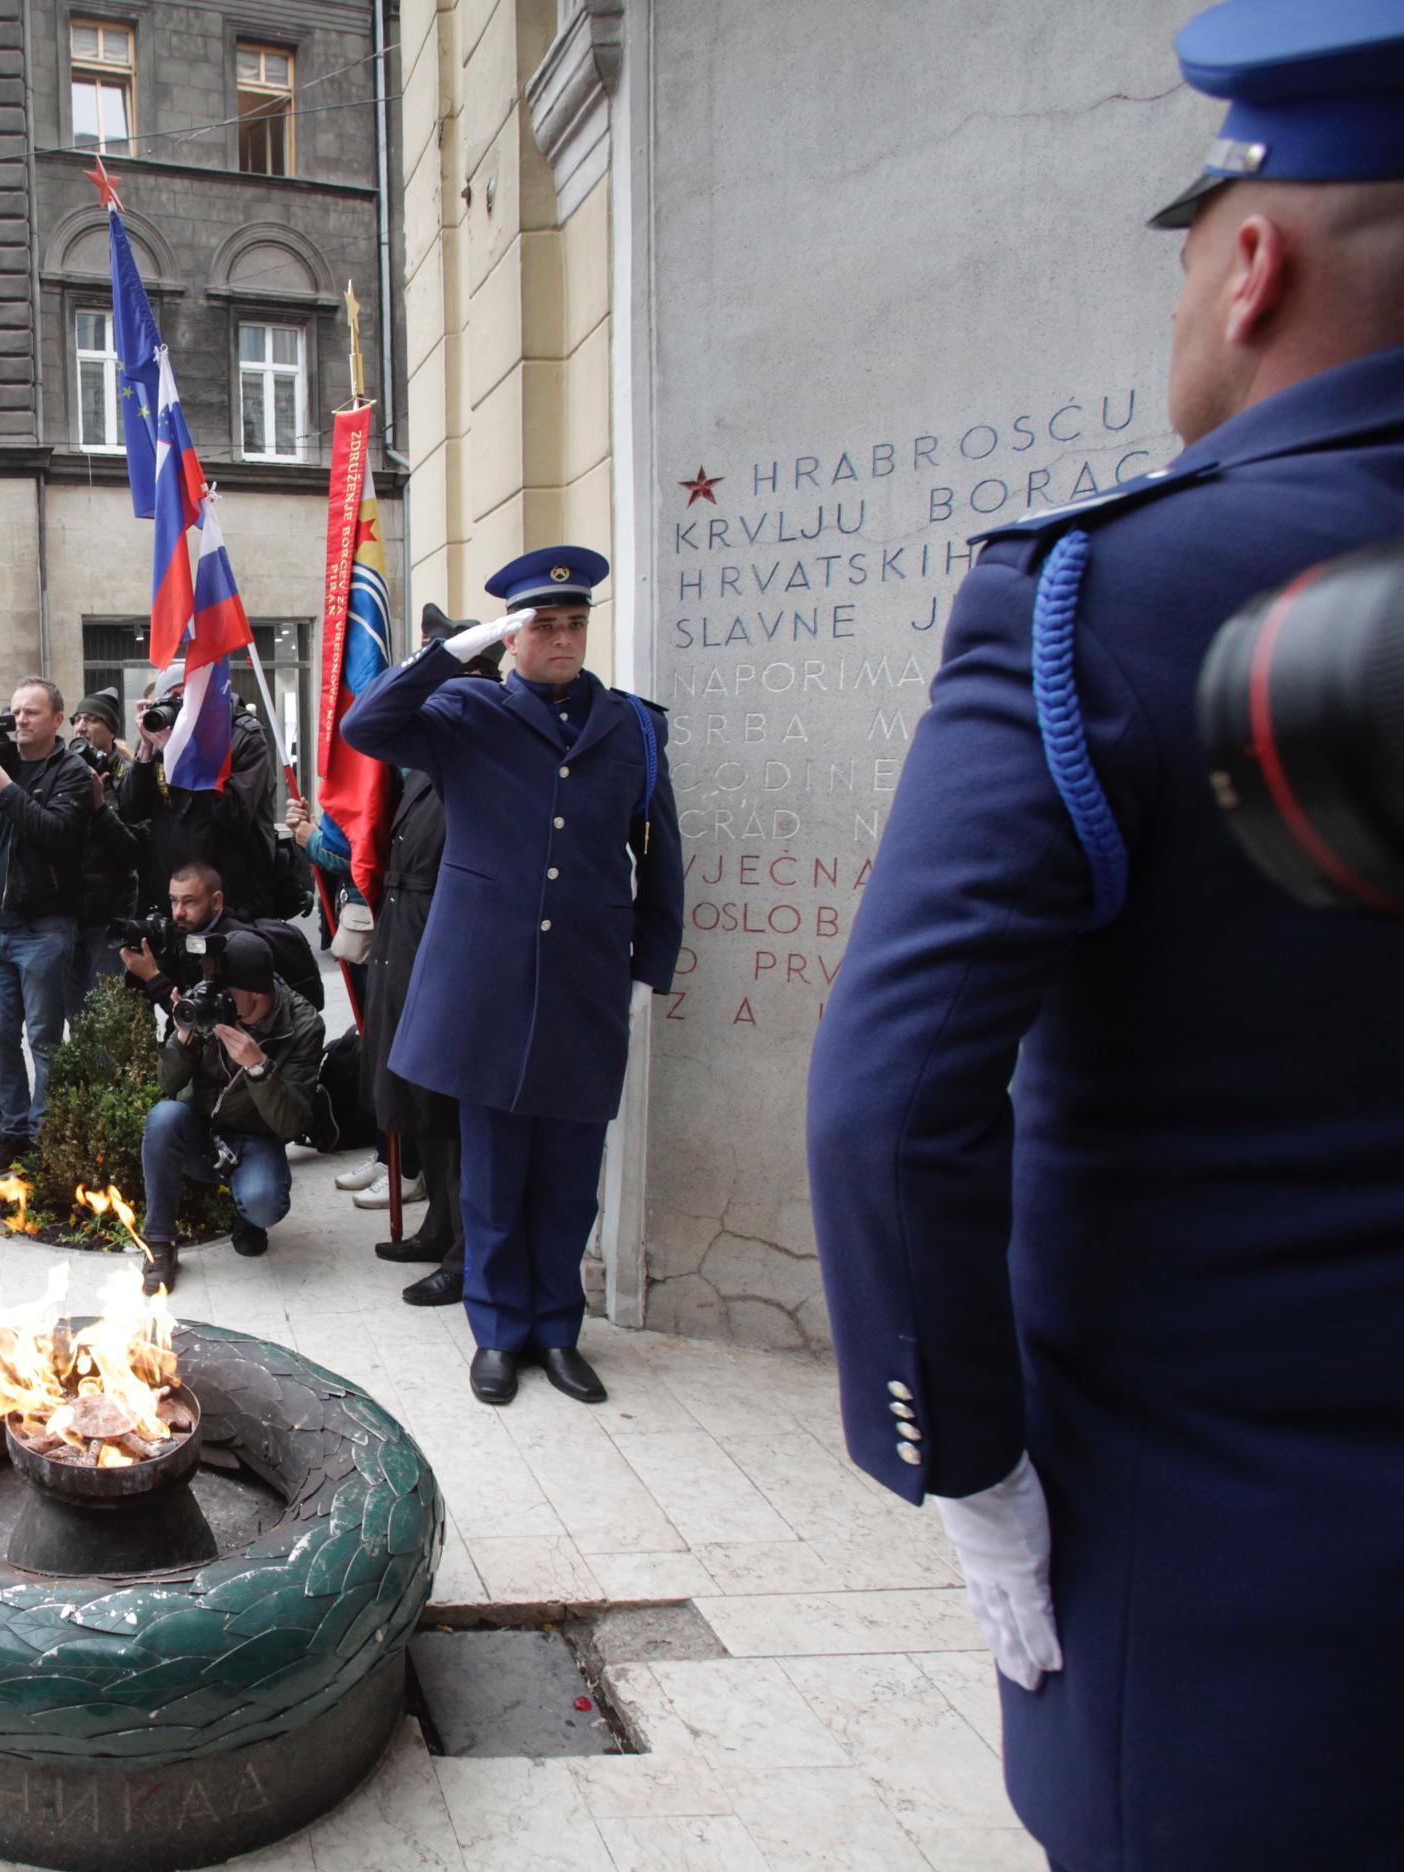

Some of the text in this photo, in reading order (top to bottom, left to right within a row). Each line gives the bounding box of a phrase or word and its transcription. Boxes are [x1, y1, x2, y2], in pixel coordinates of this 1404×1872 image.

[344, 431, 362, 521] ZDRUŽENJE
[675, 450, 1150, 554] KRVLJU BORAC
[679, 541, 973, 600] HRVATSKIH
[675, 596, 937, 649] SLAVNE J
[672, 653, 927, 699] NAPORIMA
[867, 709, 909, 741] M
[853, 808, 879, 841] N
[692, 901, 839, 937] OSLOB
[753, 950, 843, 986] PRV
